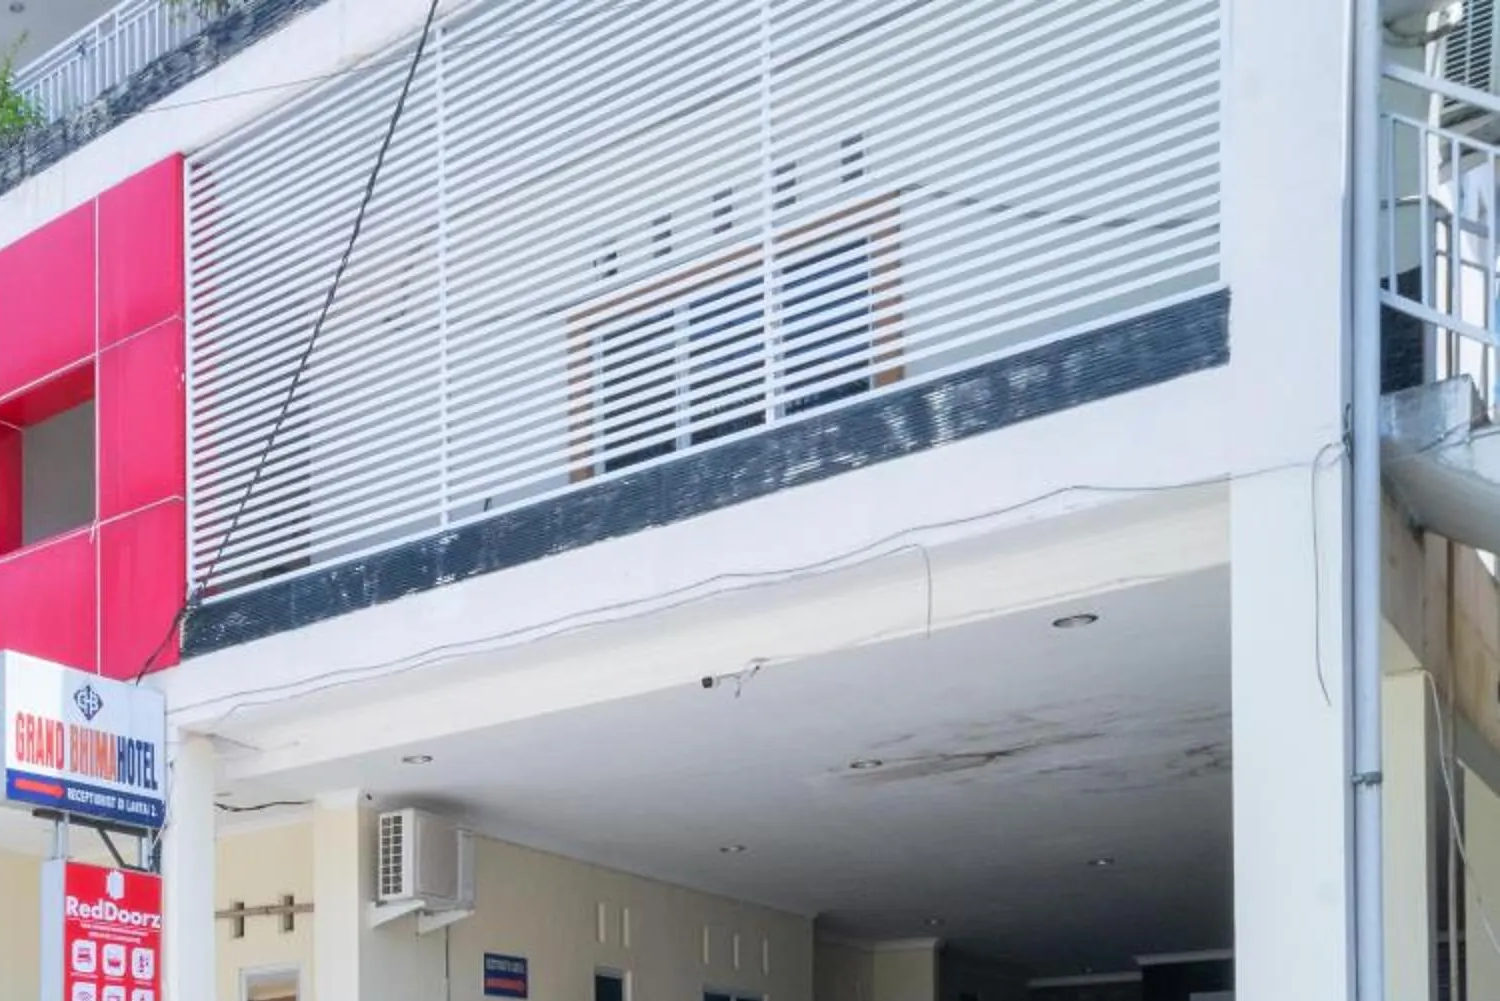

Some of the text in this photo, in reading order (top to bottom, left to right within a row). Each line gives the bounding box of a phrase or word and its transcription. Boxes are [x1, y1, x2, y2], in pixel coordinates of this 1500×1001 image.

[15, 712, 65, 770] GRAND
[117, 735, 159, 790] HOTEL
[66, 895, 161, 929] RedDoorz
